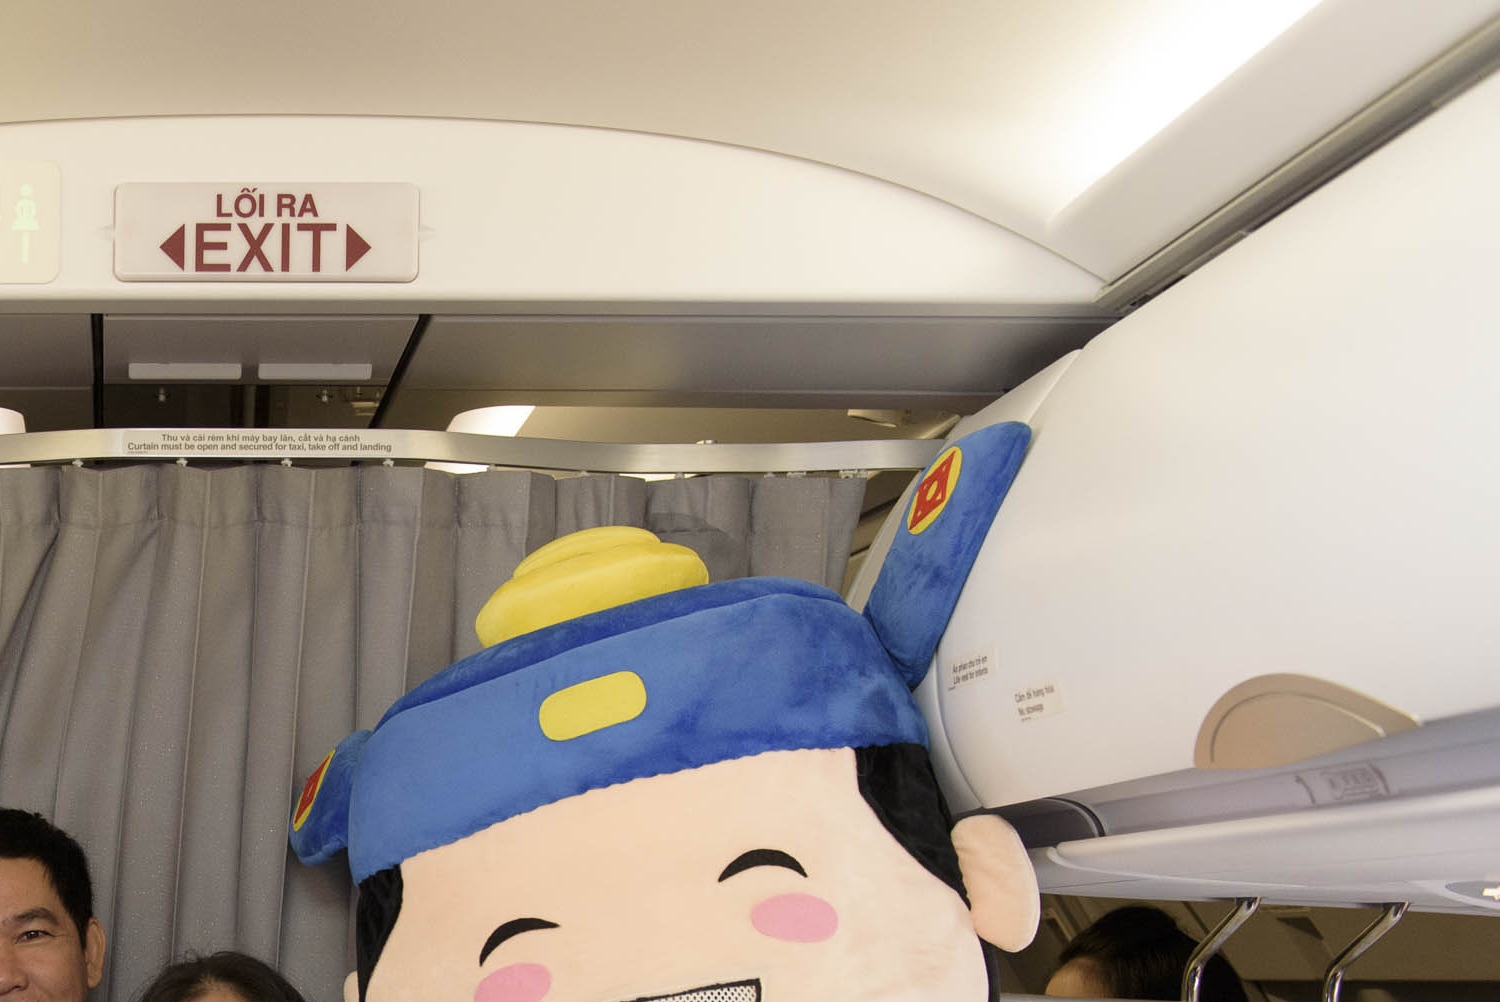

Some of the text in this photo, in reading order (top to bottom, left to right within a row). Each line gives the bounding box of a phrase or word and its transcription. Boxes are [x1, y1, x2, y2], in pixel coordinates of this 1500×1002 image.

[216, 188, 319, 217] LỐI RA
[195, 223, 337, 272] EXIT
[127, 442, 392, 453] Curtain must be open and secured for taxi, take off and landing
[162, 434, 178, 442] Thu
[180, 434, 190, 442] và
[226, 434, 239, 442] khi
[242, 434, 260, 444] máy
[262, 434, 278, 444] bay
